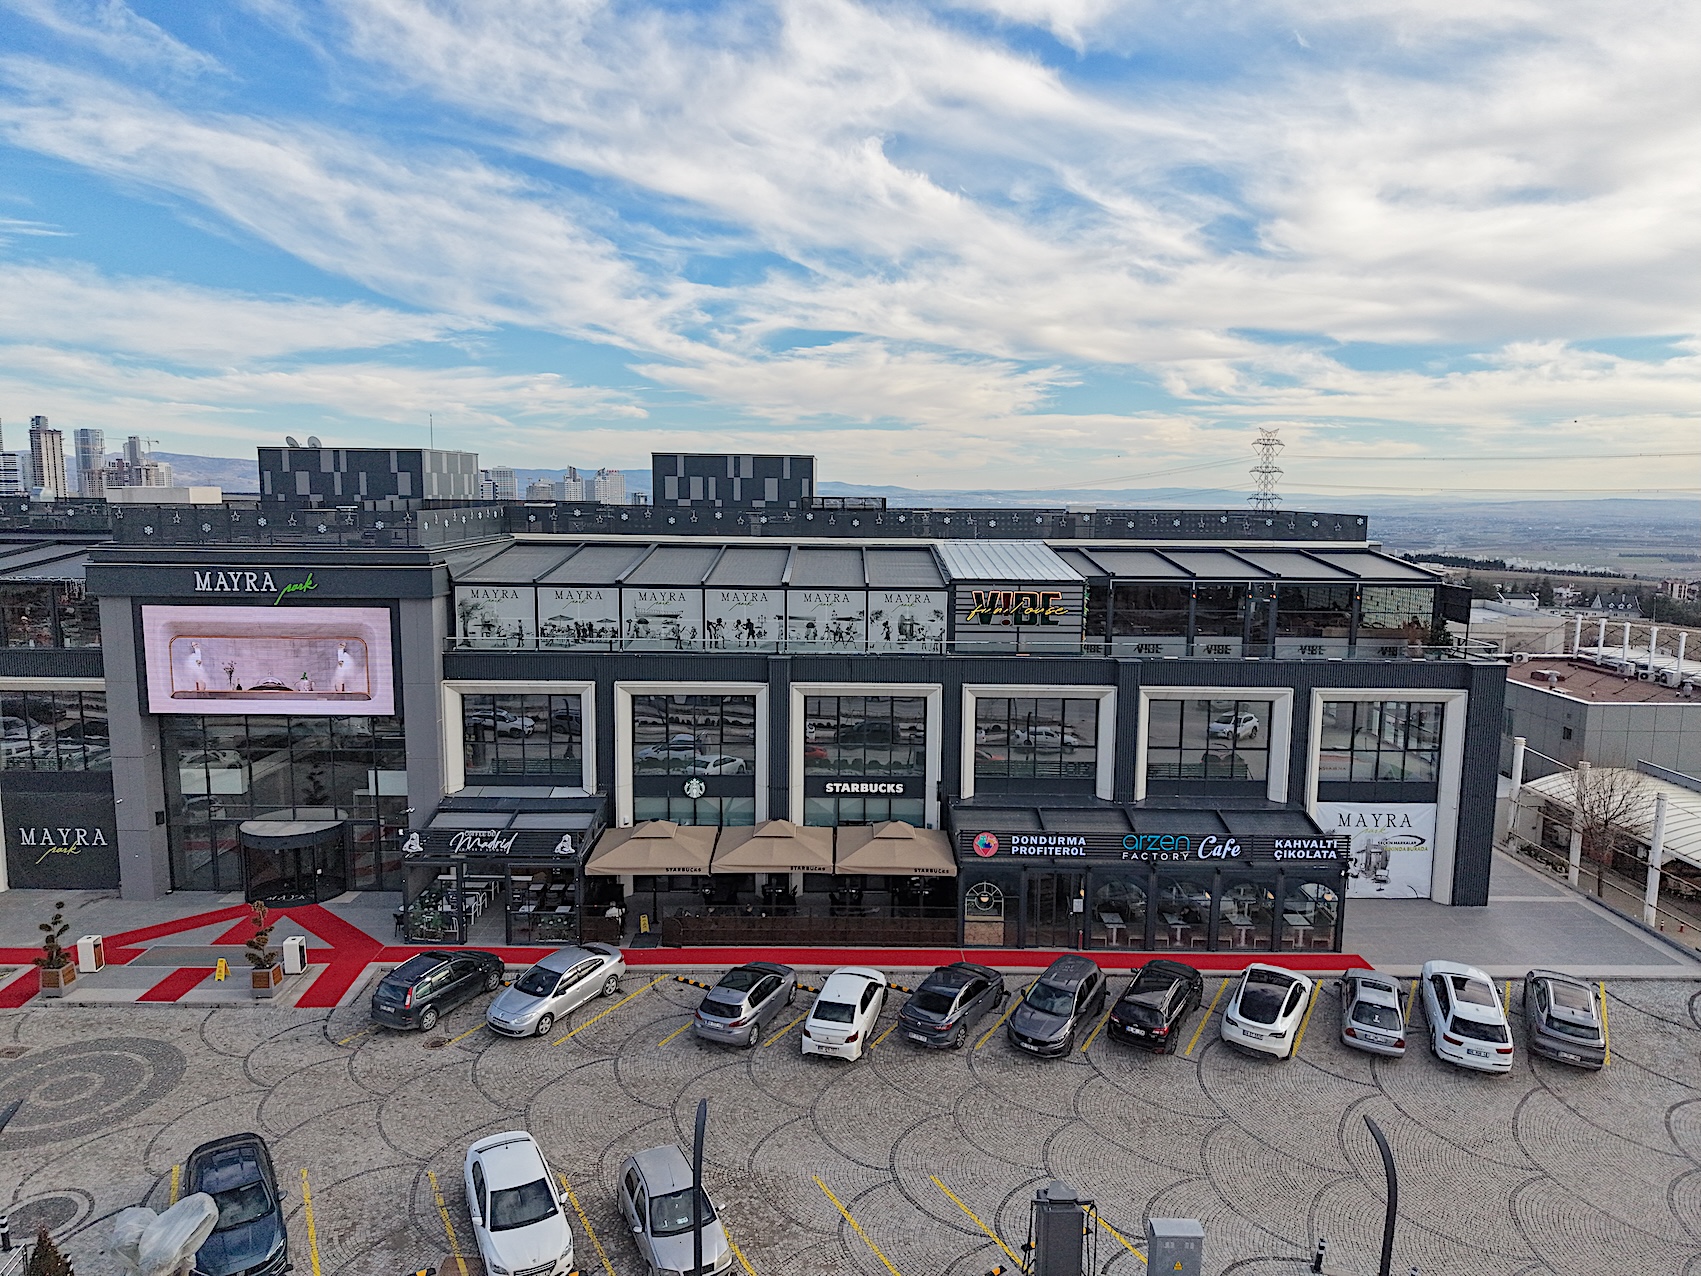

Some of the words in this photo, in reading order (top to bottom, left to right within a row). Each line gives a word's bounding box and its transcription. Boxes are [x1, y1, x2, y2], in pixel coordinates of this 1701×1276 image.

[194, 571, 278, 592] MAYRA
[273, 572, 318, 605] park
[470, 589, 519, 599] MAYRA
[554, 590, 603, 600] MAYRA
[638, 591, 687, 602] MAYRA
[721, 592, 769, 602] MAYRA
[803, 593, 850, 603] MAYRA
[884, 593, 931, 604] MAYRA
[825, 782, 904, 794] STARBUCKS
[1338, 813, 1412, 828] MAYRA
[19, 828, 108, 846] MAYRA
[449, 830, 519, 854] Madrid
[1011, 835, 1087, 846] DONDURMA
[1122, 834, 1191, 851] arzen
[1197, 835, 1241, 859] Cafe
[1274, 839, 1337, 849] KAHVALTI
[35, 840, 81, 865] park
[1122, 851, 1189, 861] FACTORY
